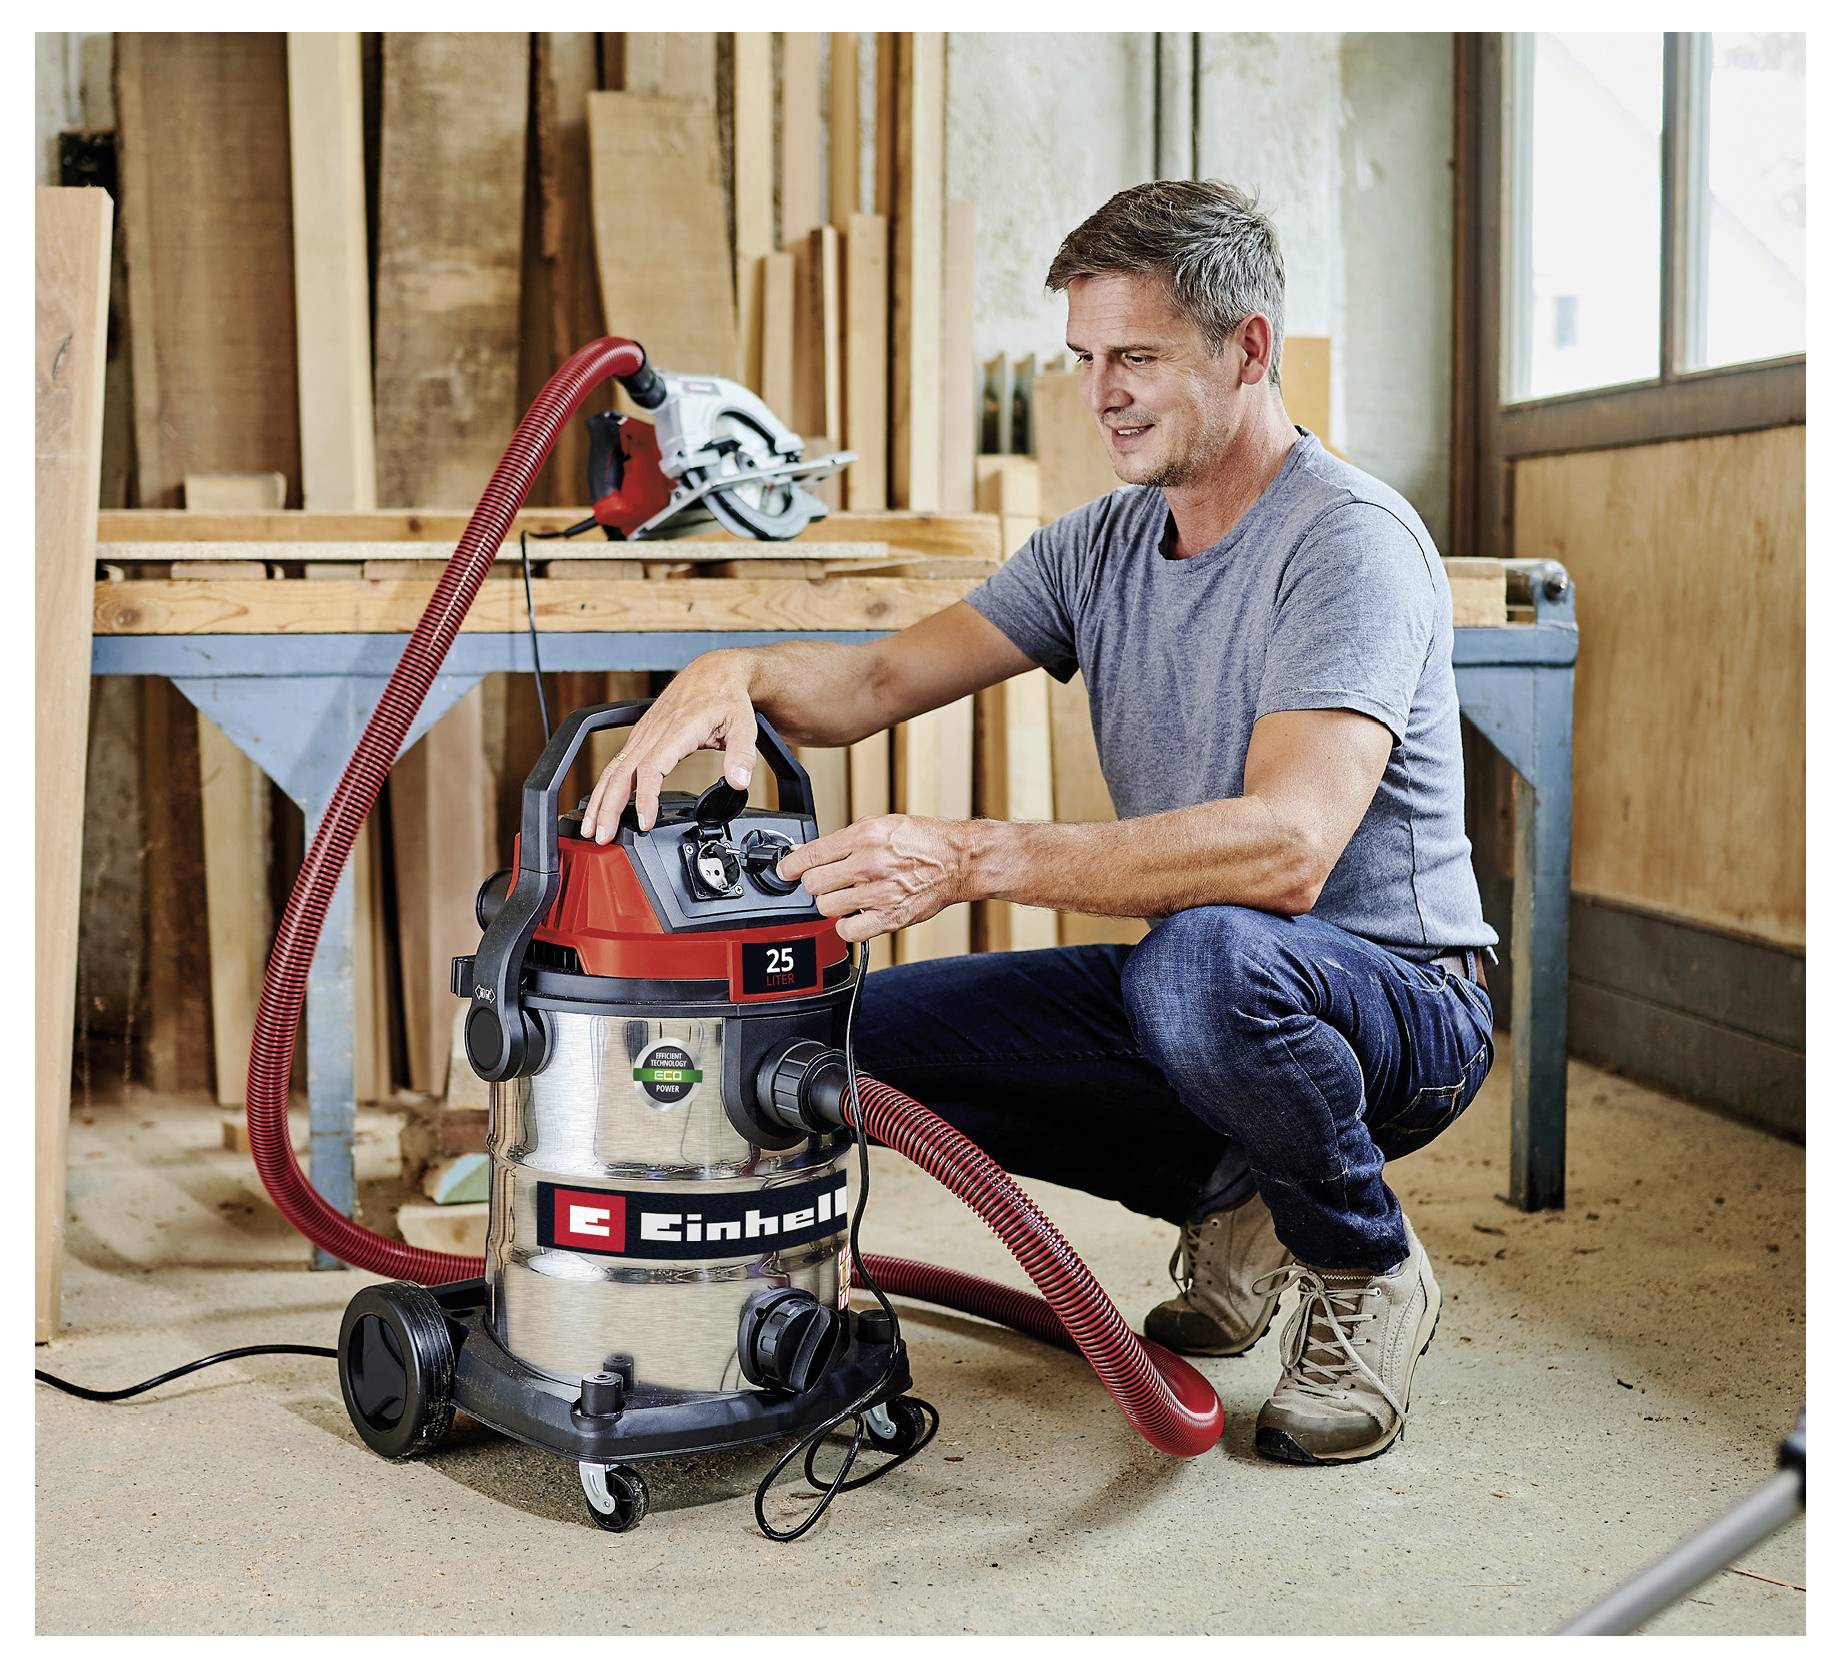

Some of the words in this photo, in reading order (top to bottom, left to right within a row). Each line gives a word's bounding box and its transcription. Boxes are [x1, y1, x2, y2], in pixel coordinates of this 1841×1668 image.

[766, 947, 794, 974] 25
[766, 973, 795, 986] LITER
[655, 1052, 682, 1060] EFFICIENT
[654, 1070, 682, 1081] ECO
[656, 1085, 680, 1093] POWER
[641, 1186, 847, 1241] Einhell
